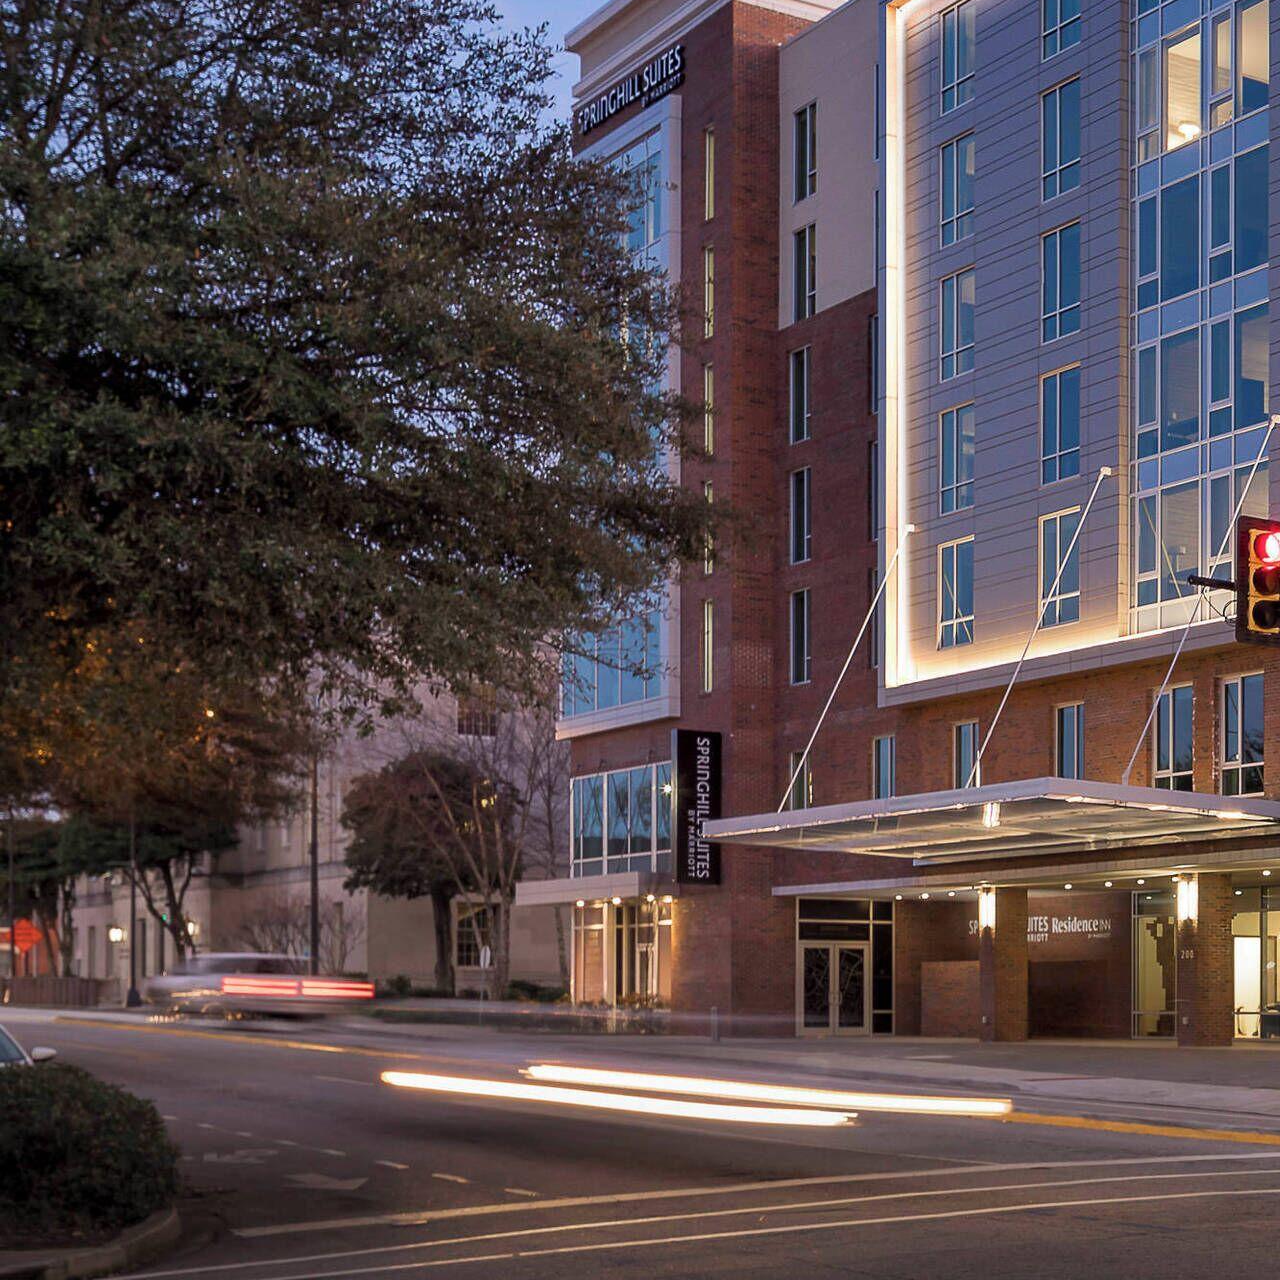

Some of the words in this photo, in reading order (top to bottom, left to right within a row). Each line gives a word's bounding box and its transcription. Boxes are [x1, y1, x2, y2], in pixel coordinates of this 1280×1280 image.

[577, 73, 641, 135] SPRINGHILL
[643, 44, 681, 93] SUITES
[697, 737, 710, 825] SPRINGHILL
[688, 809, 695, 823] BY
[1052, 916, 1099, 933] Residence
